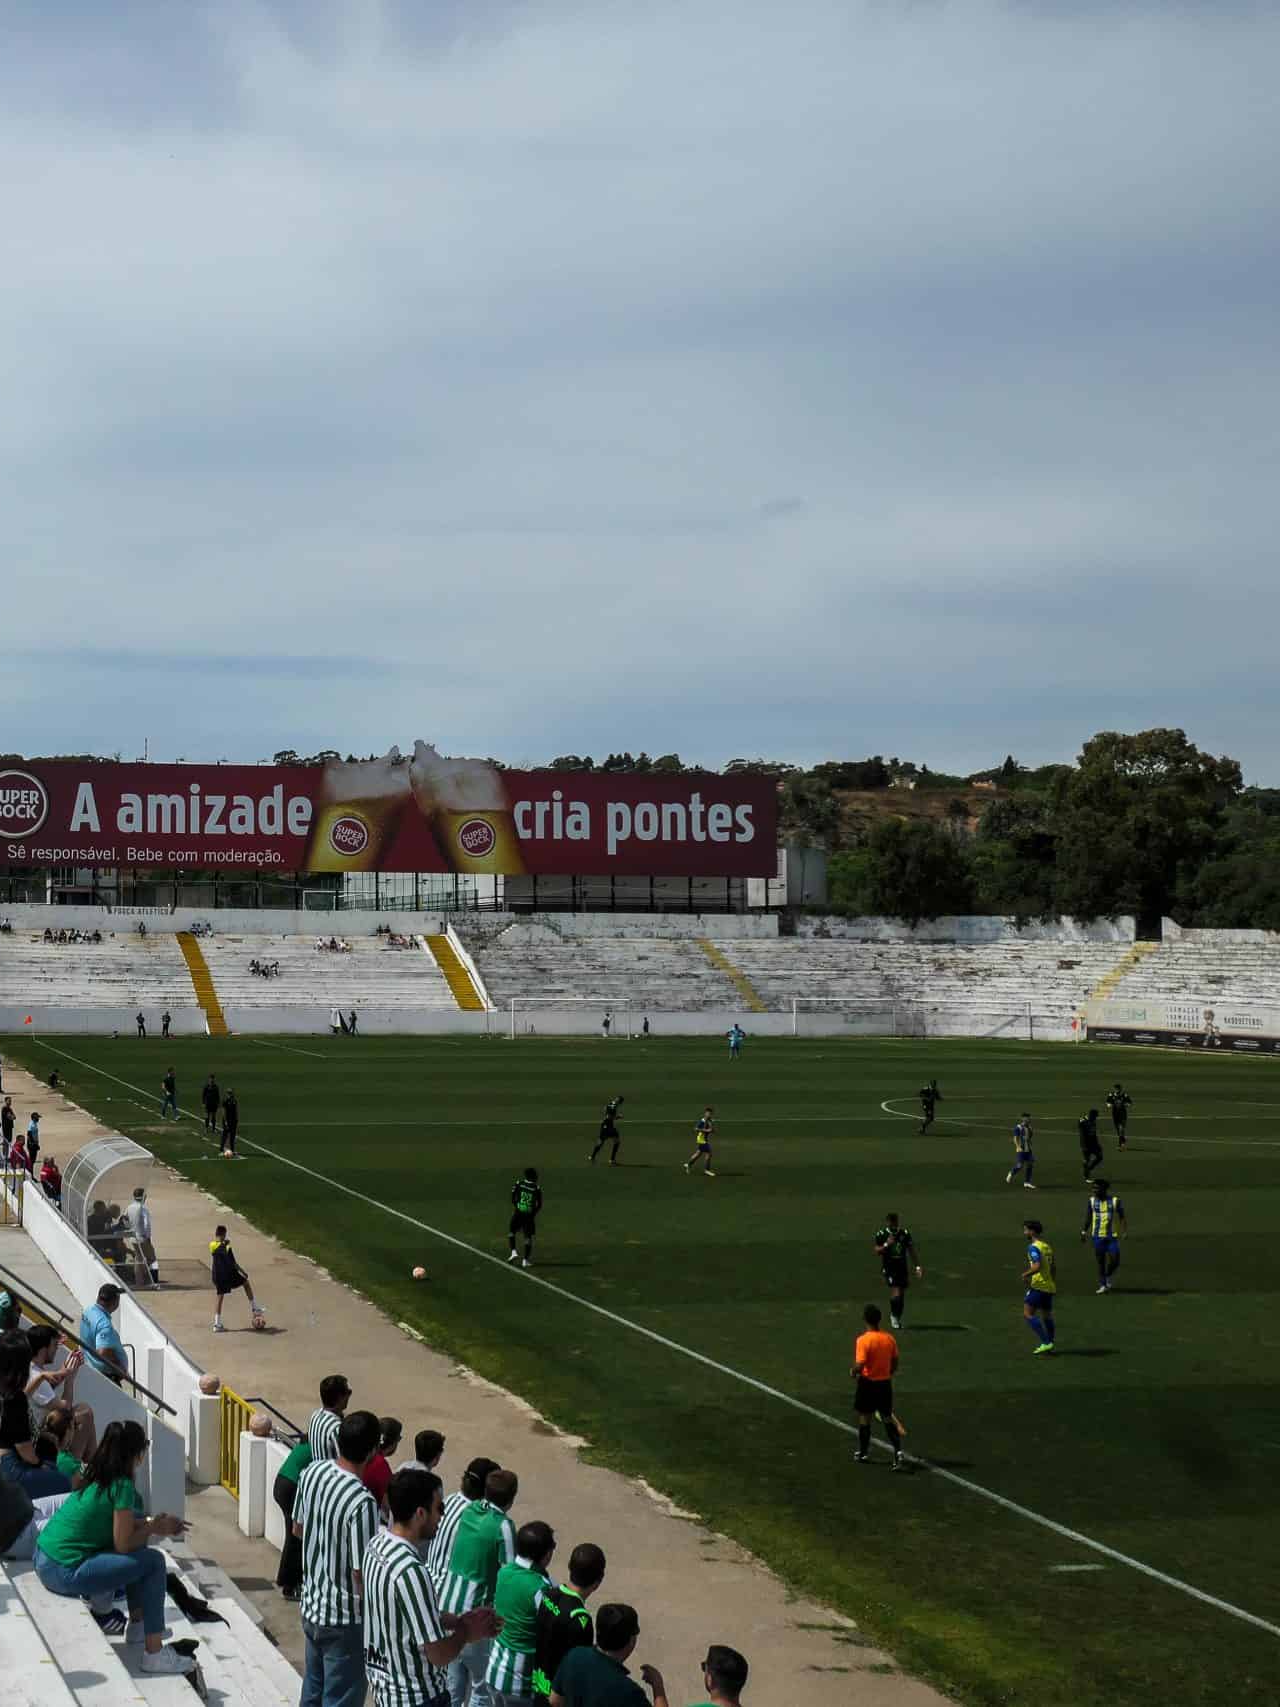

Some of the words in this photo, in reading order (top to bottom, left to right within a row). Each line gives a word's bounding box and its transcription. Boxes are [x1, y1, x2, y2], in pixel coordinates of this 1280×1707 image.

[70, 782, 101, 832] A
[116, 783, 313, 836] amizade
[513, 790, 590, 840] cria
[606, 792, 755, 856] pontes
[335, 824, 364, 841] SUPER
[7, 844, 26, 859] Sê
[31, 846, 121, 862] responsável.
[126, 846, 163, 861] Bebe
[168, 850, 198, 862] com
[204, 848, 286, 866] moderação.
